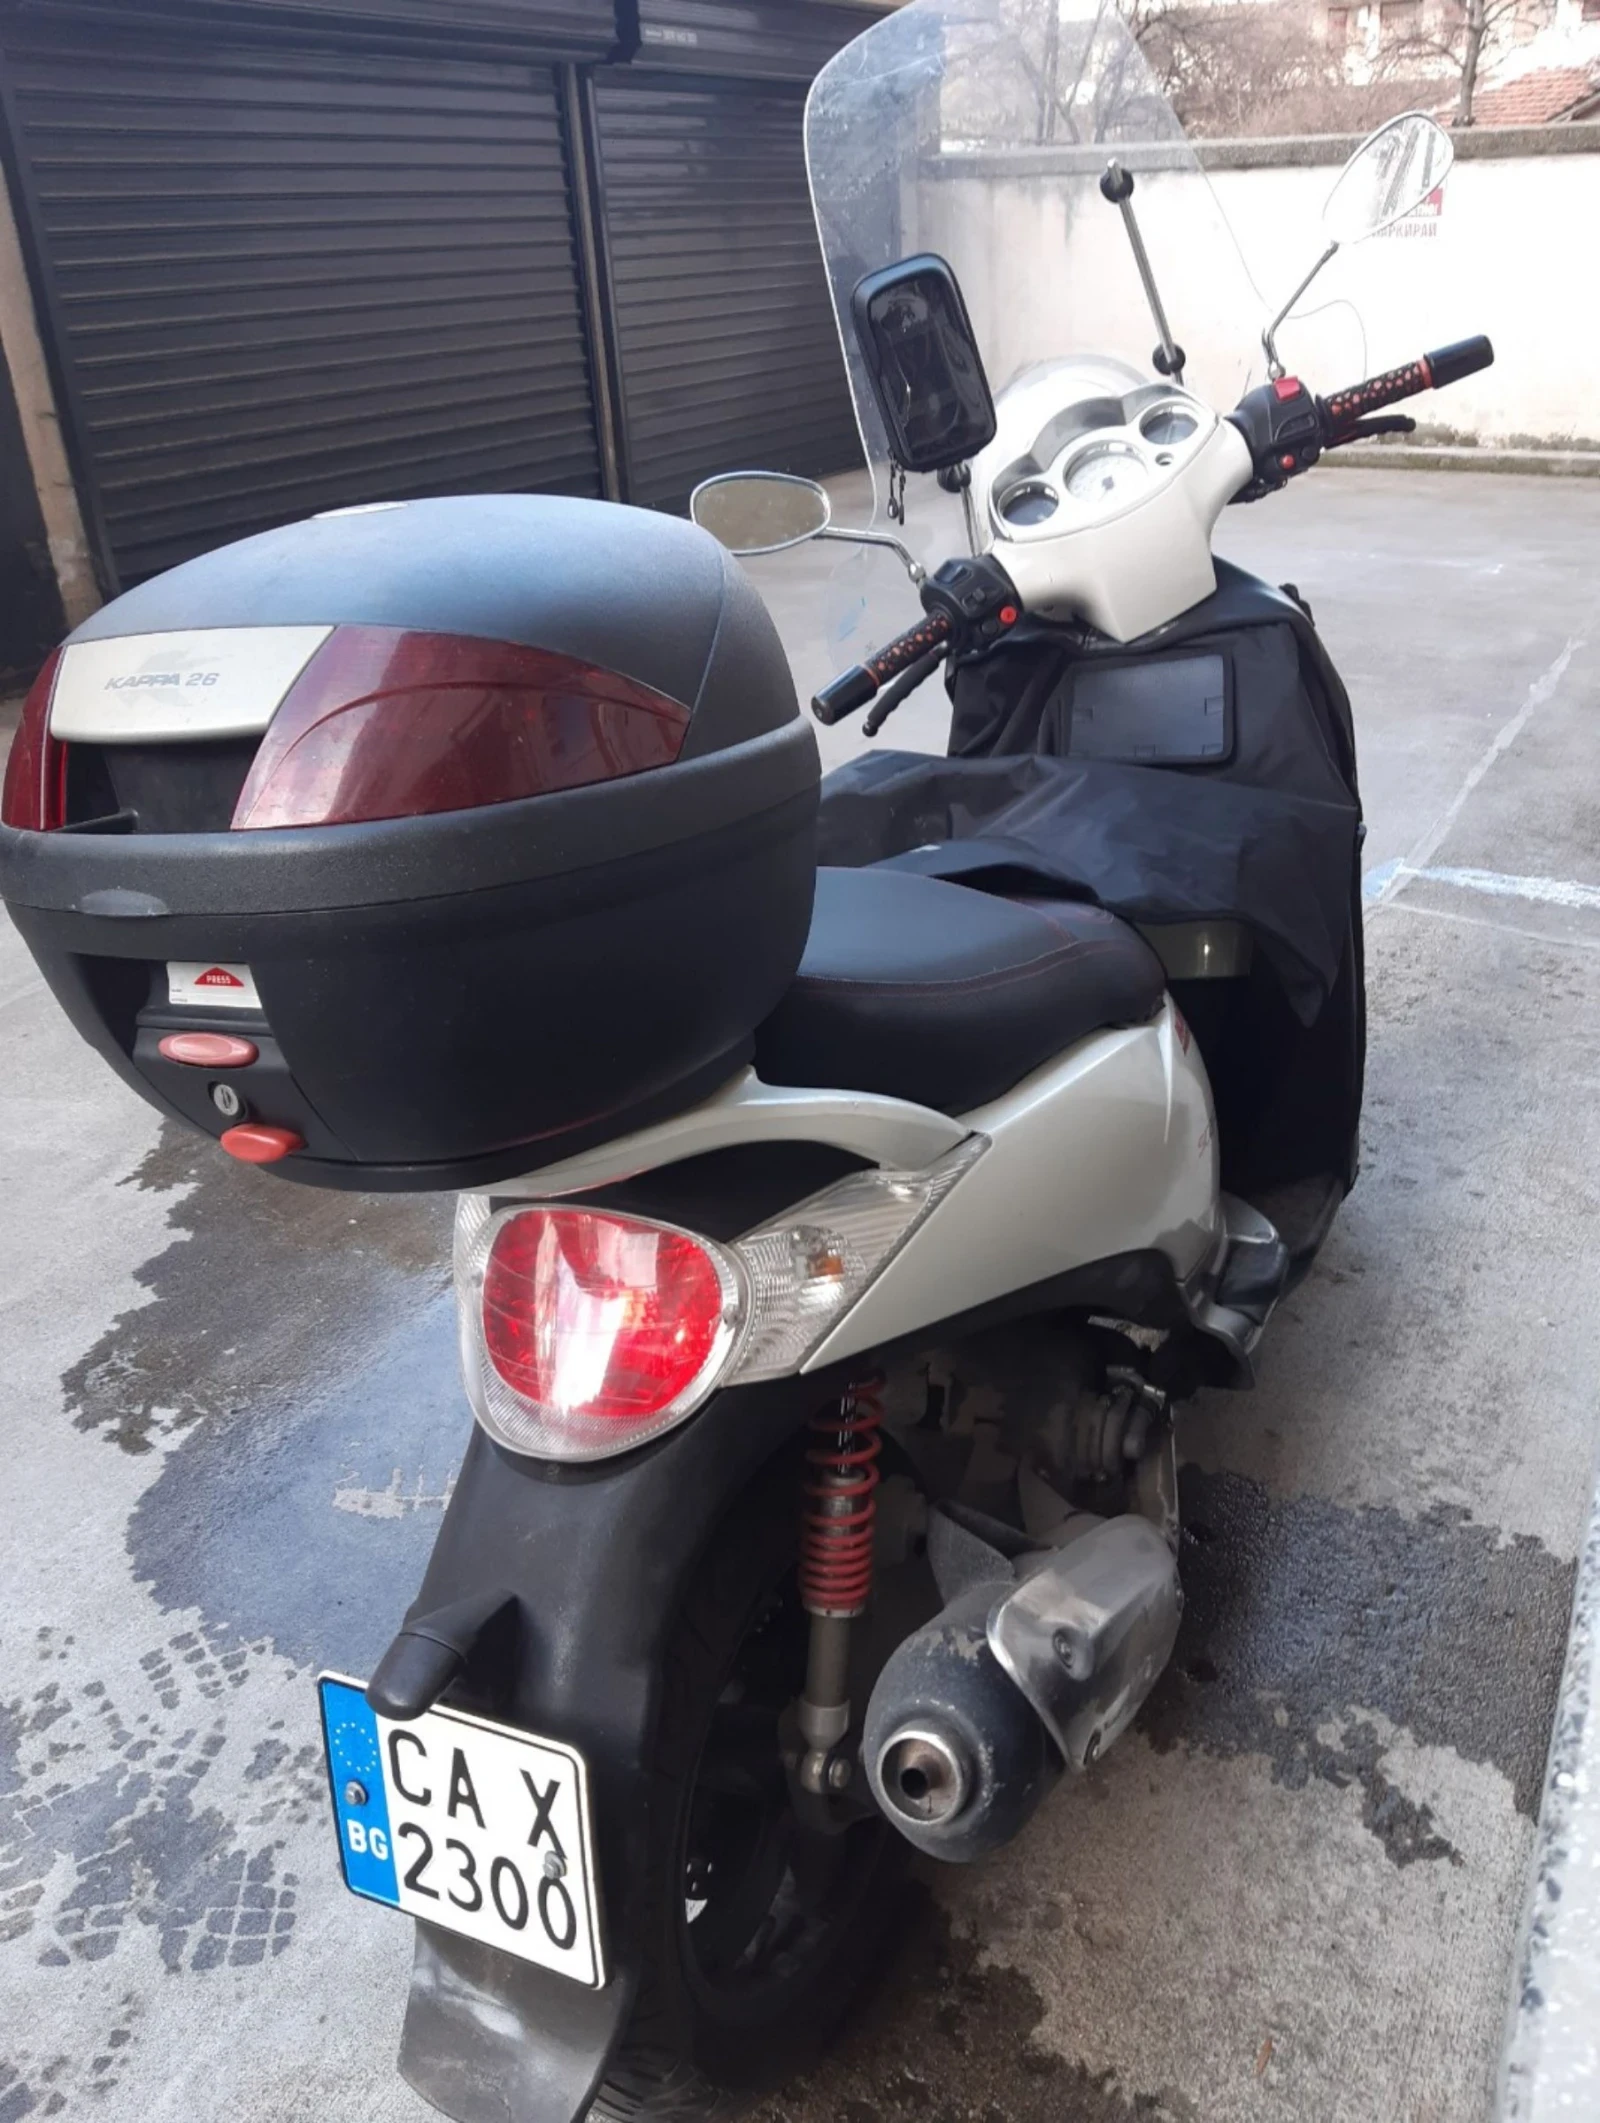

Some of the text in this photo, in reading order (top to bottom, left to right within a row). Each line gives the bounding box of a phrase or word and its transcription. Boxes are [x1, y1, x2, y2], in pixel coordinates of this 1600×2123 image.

[104, 672, 220, 690] KAPPA 26
[206, 975, 231, 984] PRESS
[346, 1818, 389, 1861] BG
[397, 1821, 577, 1950] 2300
